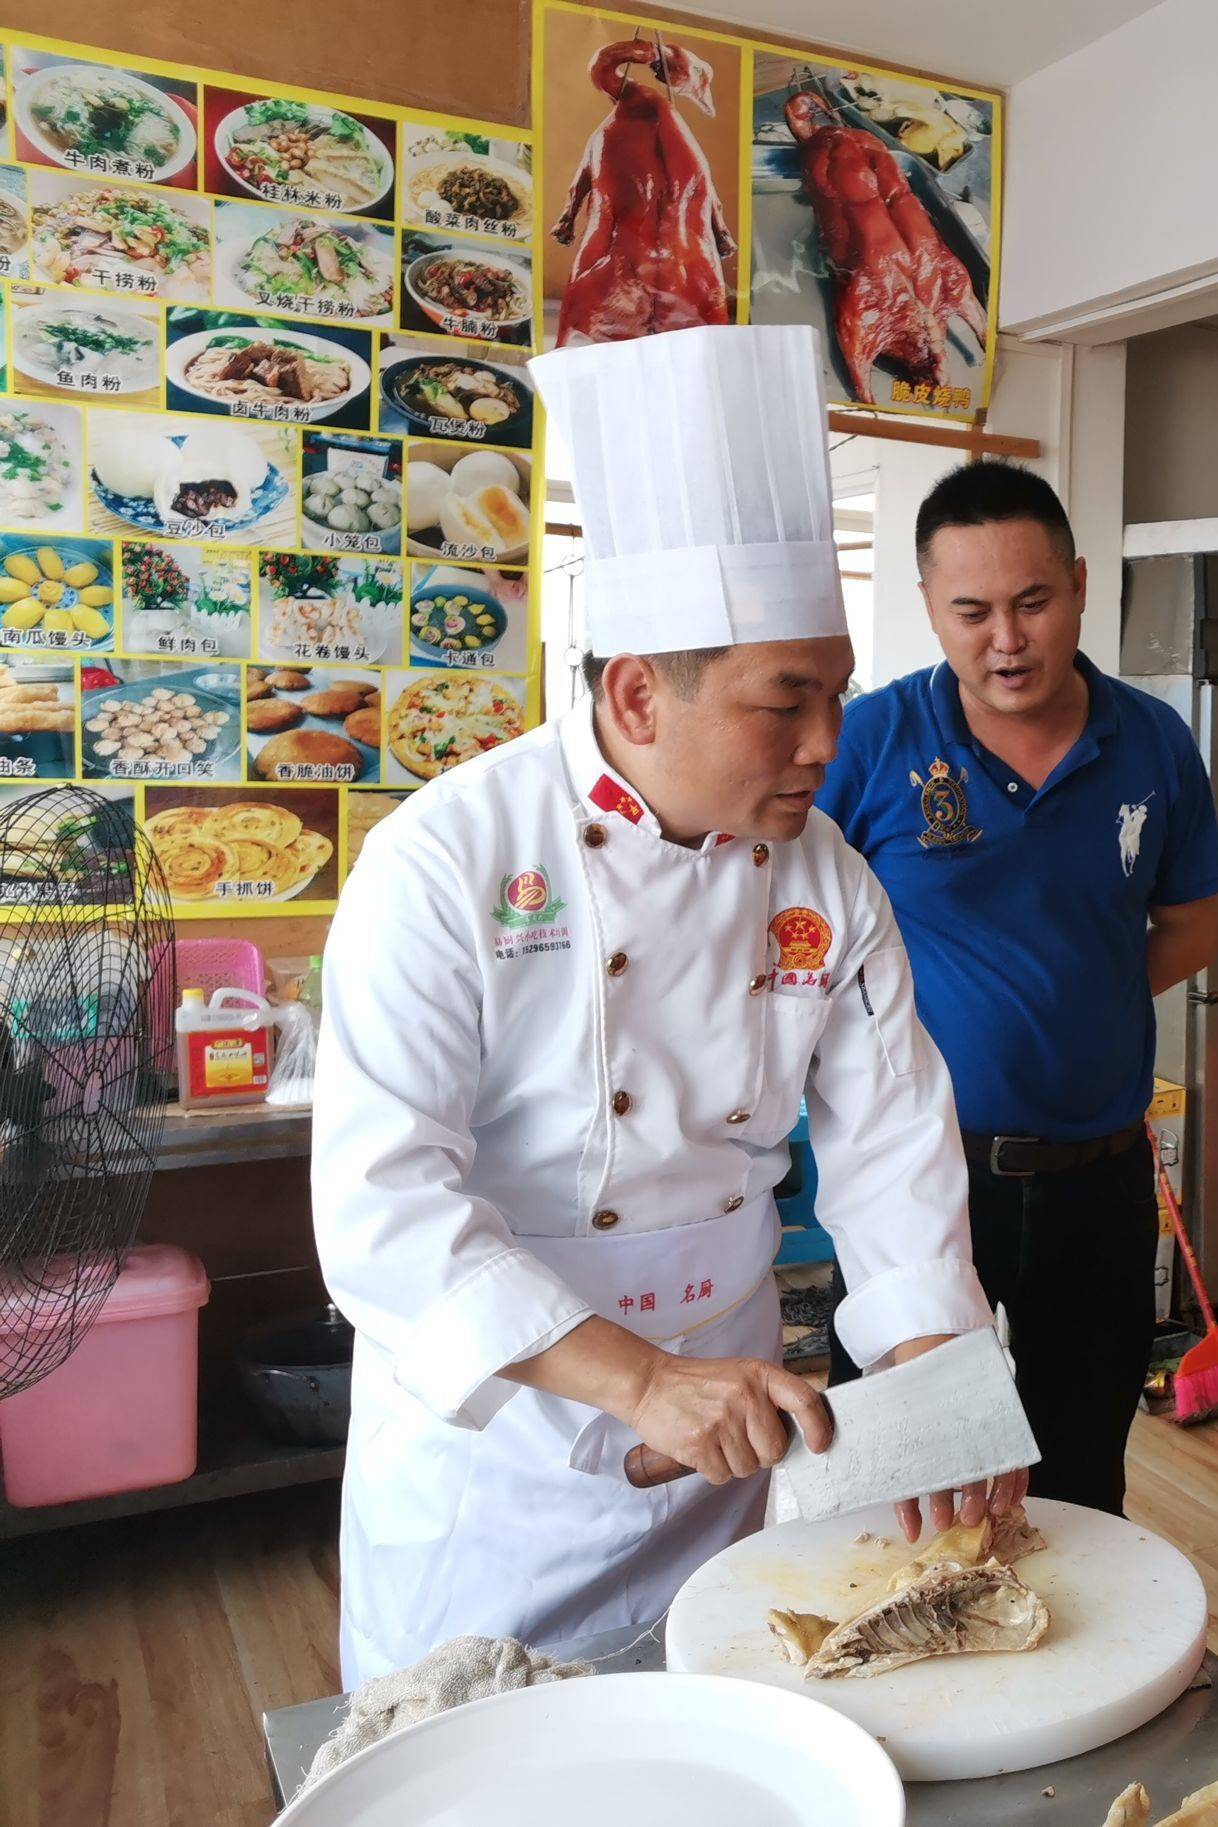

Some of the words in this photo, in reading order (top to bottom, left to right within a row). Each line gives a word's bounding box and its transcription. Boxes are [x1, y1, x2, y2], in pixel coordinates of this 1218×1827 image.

[65, 151, 156, 180] 牛肉煮粉
[261, 183, 342, 209] 桂林米粉
[425, 209, 518, 237] 酸菜肉丝粉
[92, 268, 157, 292] 干捞粉
[257, 291, 355, 317] 叉烧干捞粉
[442, 316, 498, 338] 牛腩粉
[56, 370, 121, 392] 鱼肉粉
[891, 379, 972, 409] 脆皮烧鸭
[231, 401, 311, 421] 卤牛肉粉
[429, 417, 487, 438] 瓦煲粉
[166, 520, 226, 539] 豆沙包
[323, 534, 381, 551] 小笼包
[441, 542, 496, 560] 流沙包
[3, 629, 91, 647] 南瓜馒头
[158, 636, 219, 655] 鲜肉包
[294, 645, 370, 662] 花卷馒头
[445, 651, 496, 667] 卡通包
[112, 760, 215, 776] 香酥开口笑
[277, 764, 355, 779] 香脆油饼
[215, 881, 275, 896] 手抓饼
[618, 1292, 656, 1315] 中国
[680, 1279, 714, 1304] 名厨
